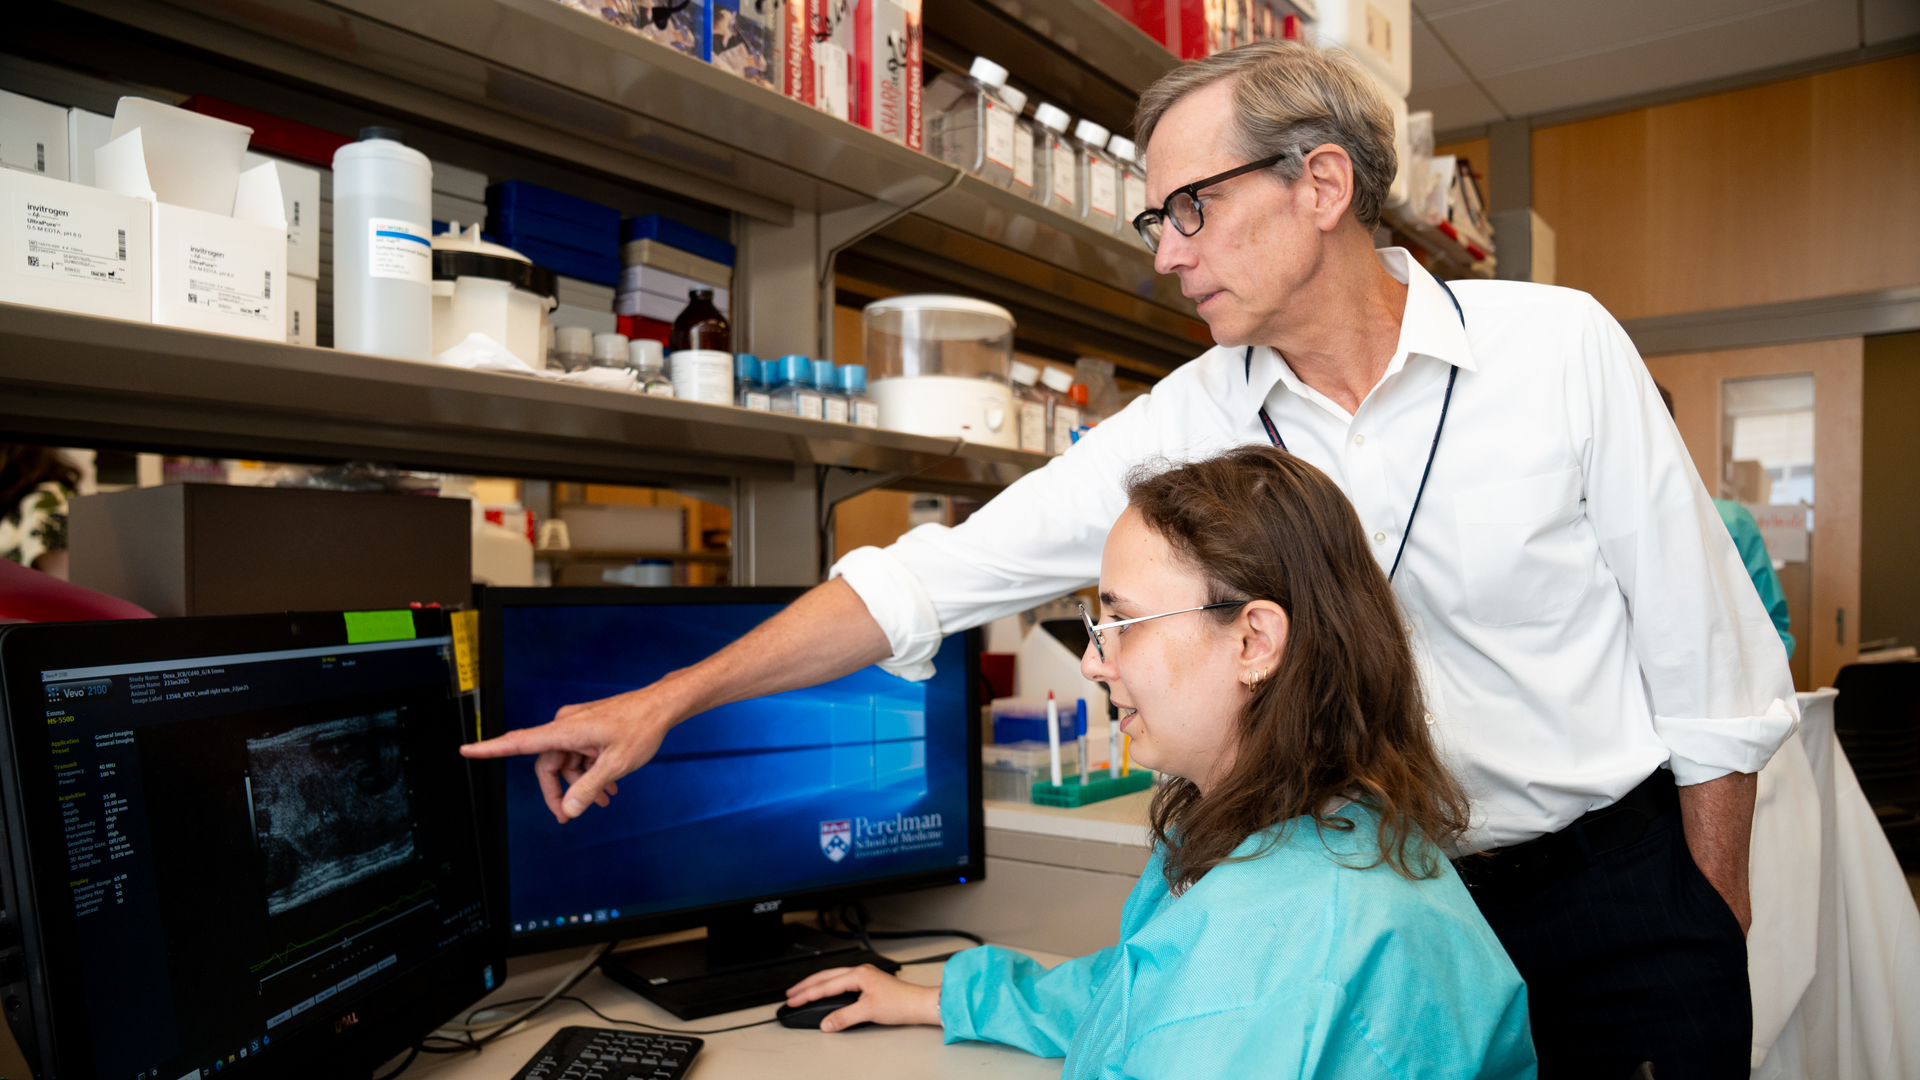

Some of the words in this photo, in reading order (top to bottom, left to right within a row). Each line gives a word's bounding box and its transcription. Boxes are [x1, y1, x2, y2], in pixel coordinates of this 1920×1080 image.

[880, 79, 901, 137] SHARP
[909, 66, 921, 148] Precision
[27, 202, 69, 217] invitrogen
[190, 244, 224, 258] invitrogen
[63, 688, 84, 698] Vevo
[87, 685, 107, 696] 2100
[51, 738, 79, 747] Application
[94, 732, 114, 740] General
[95, 740, 114, 748] General
[115, 737, 135, 745] Imaging
[54, 762, 77, 770] Transmit
[57, 769, 84, 778] Frequency
[58, 792, 86, 801] Acquisition
[62, 808, 79, 817] Depth
[64, 816, 79, 824] Width
[76, 821, 96, 830] Density
[105, 815, 117, 823] High
[856, 812, 942, 838] Perelman
[66, 829, 96, 840] Persistence
[67, 837, 93, 847] Sensitivity
[107, 830, 119, 838] High
[856, 834, 887, 848] School
[889, 835, 899, 844] of
[901, 830, 943, 843] Medicine
[77, 853, 93, 861] Range
[78, 861, 90, 869] Step
[70, 878, 89, 887] Display
[73, 884, 95, 894] Dynamic
[96, 879, 112, 887] Range
[74, 892, 93, 901] Display
[75, 897, 103, 909] Brightness
[752, 899, 783, 914] acer
[77, 906, 99, 917] Contrast
[334, 1012, 359, 1034] DELL
